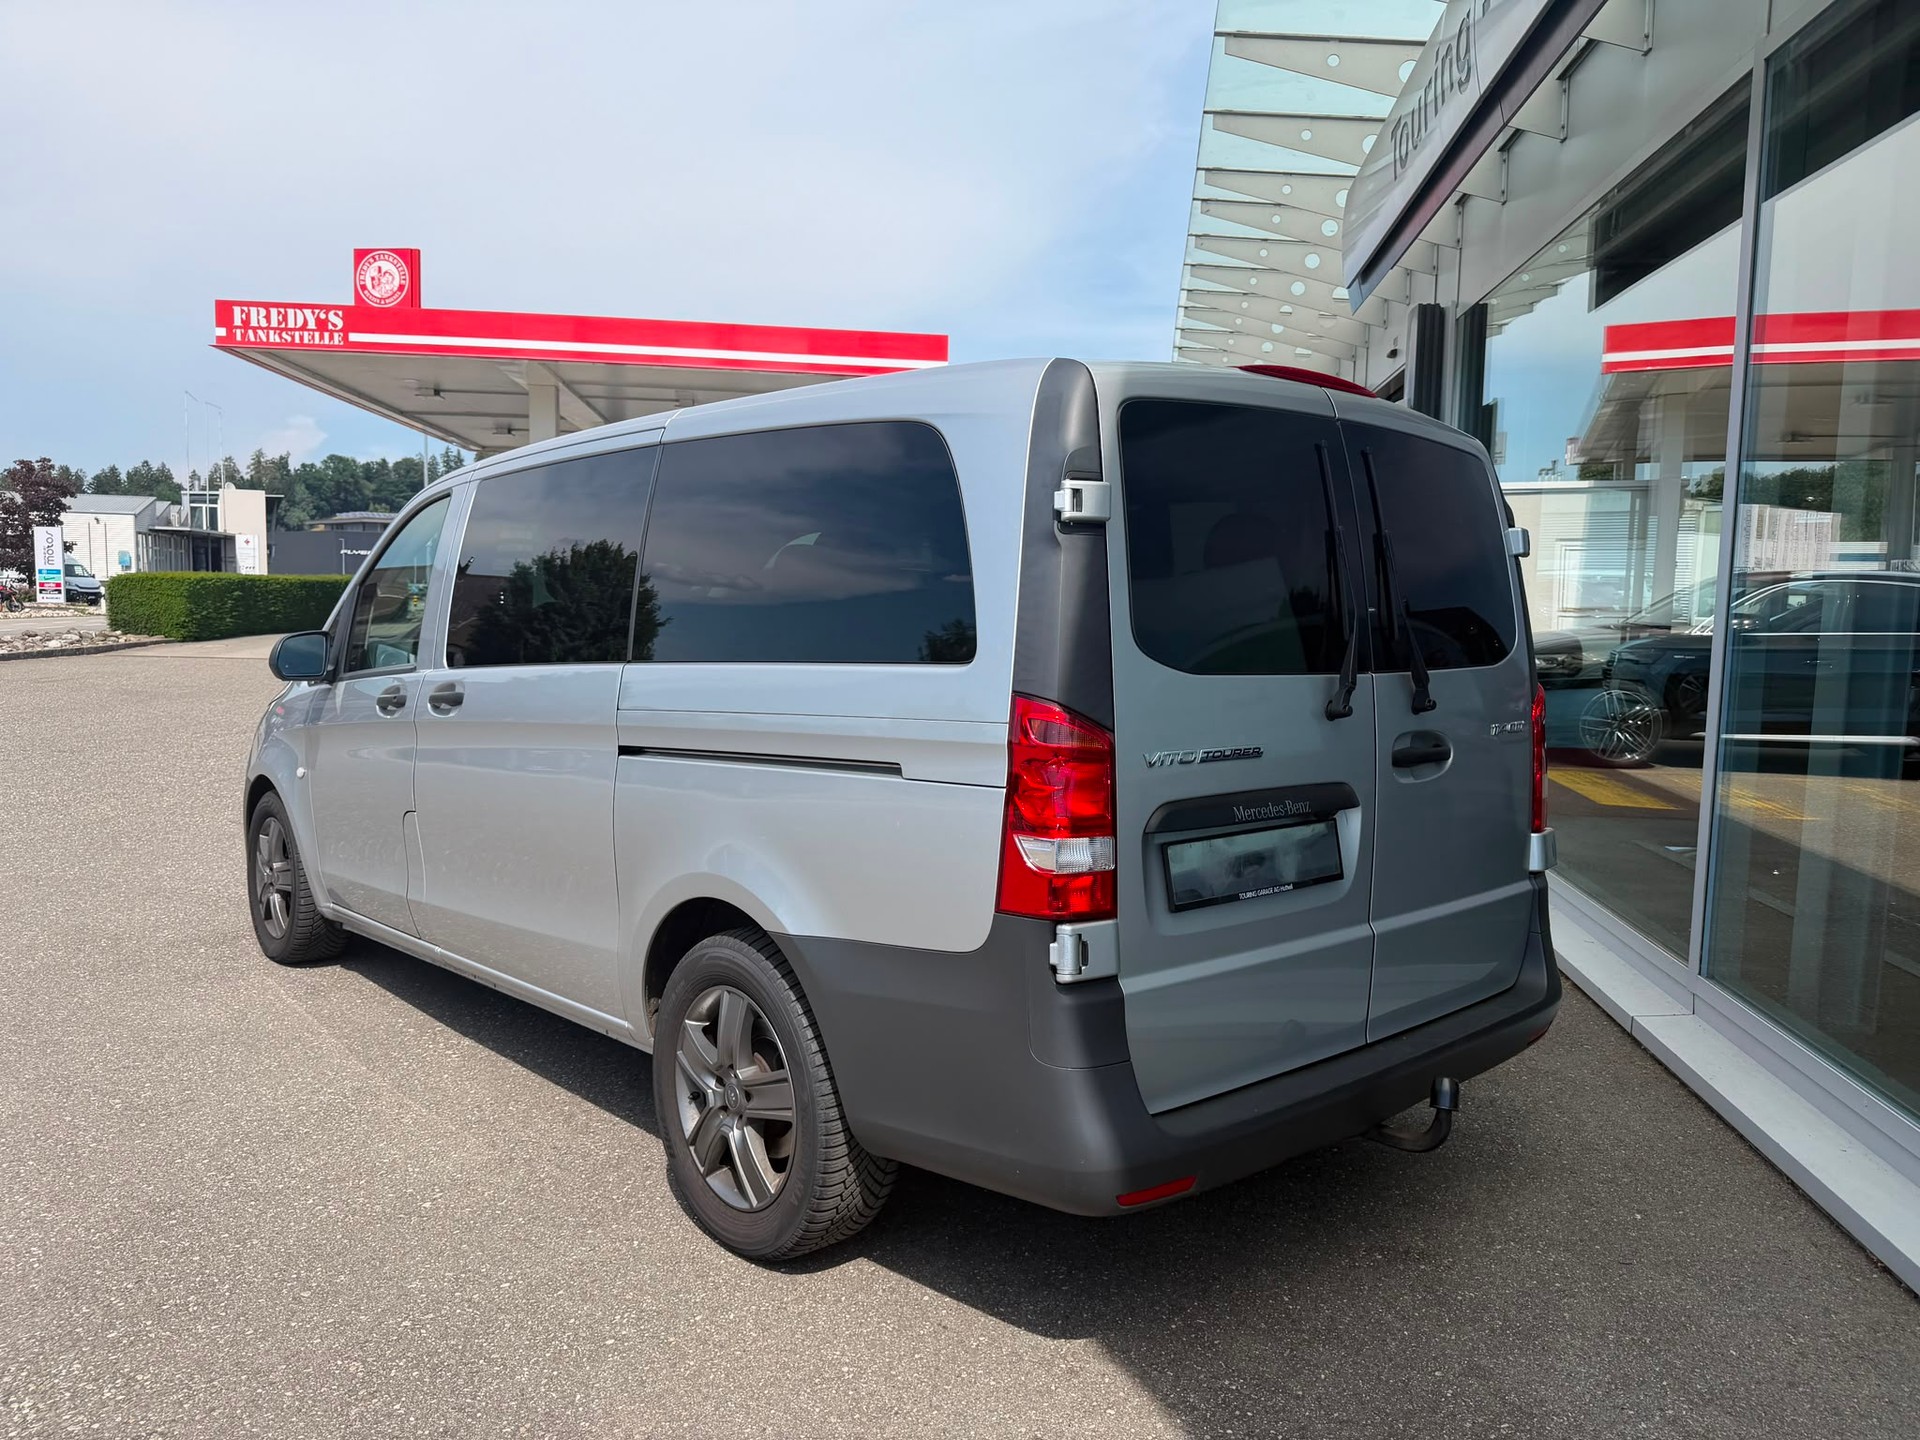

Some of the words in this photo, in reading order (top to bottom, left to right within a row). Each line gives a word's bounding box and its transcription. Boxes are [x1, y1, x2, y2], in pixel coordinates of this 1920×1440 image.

[1390, 8, 1473, 182] Touring
[231, 305, 344, 331] FREDY'S
[232, 328, 344, 346] TANKSTELLE
[1142, 749, 1197, 769] VITO
[1202, 746, 1264, 760] TOURER
[1232, 798, 1313, 824] Mercedes-Benz
